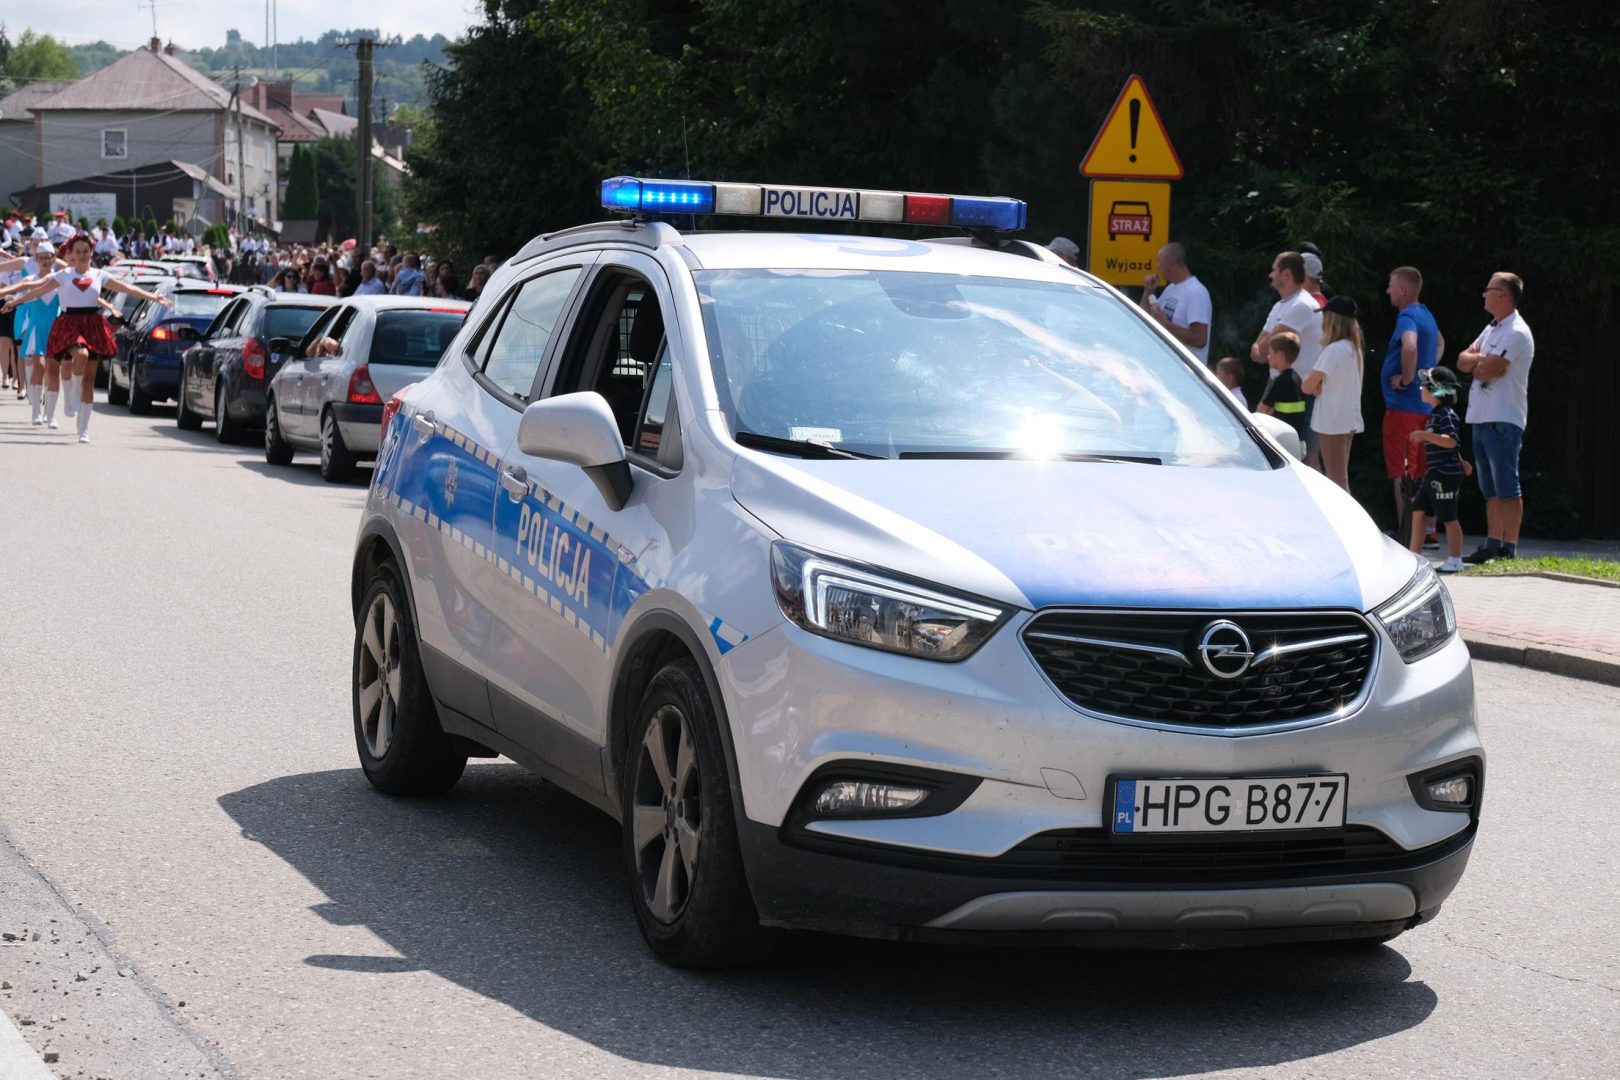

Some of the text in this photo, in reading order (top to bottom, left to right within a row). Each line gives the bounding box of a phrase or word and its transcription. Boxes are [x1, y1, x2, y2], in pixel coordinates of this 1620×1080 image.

[767, 190, 854, 217] POLICJA
[1111, 217, 1149, 232] STRAŻ
[1107, 258, 1152, 272] Wyjazd
[517, 503, 591, 609] POLICJA
[1027, 527, 1306, 562] POICJA
[1142, 781, 1339, 826] HPG B877
[1117, 812, 1131, 824] PL
